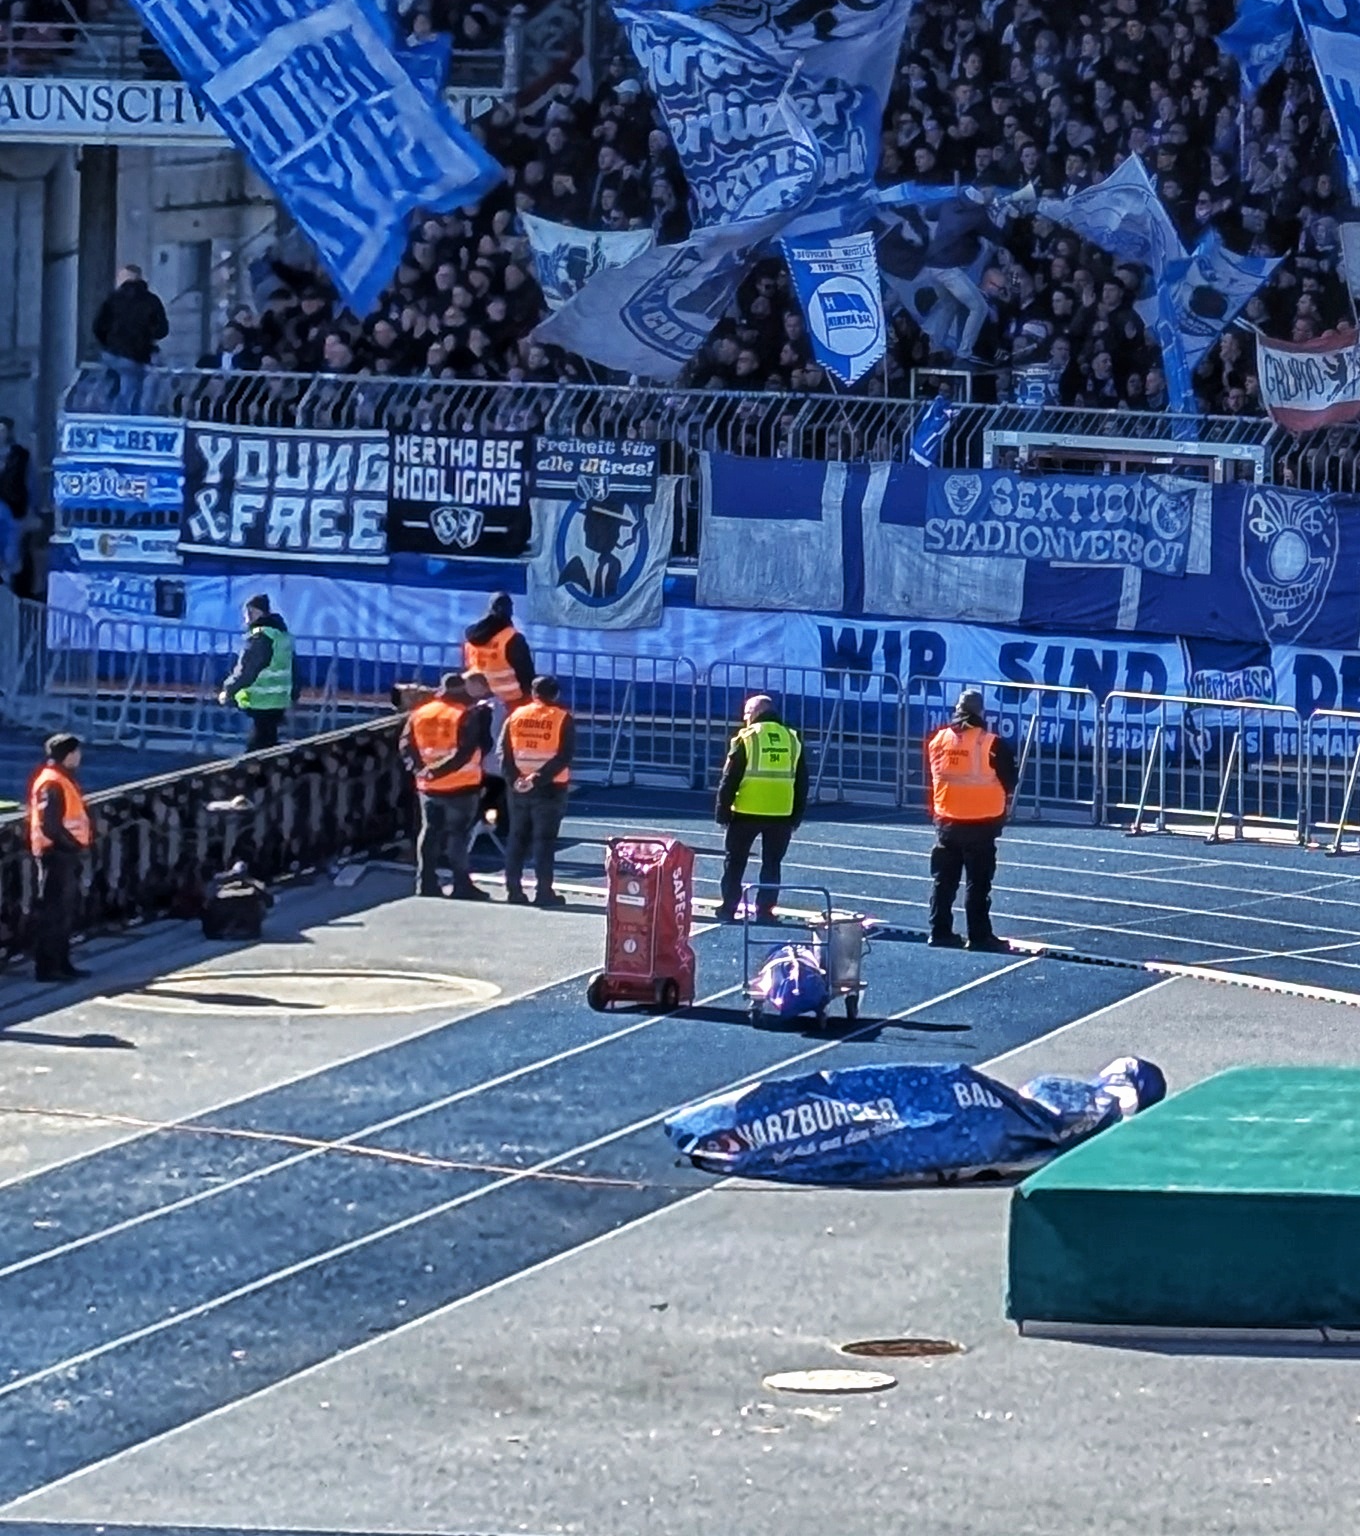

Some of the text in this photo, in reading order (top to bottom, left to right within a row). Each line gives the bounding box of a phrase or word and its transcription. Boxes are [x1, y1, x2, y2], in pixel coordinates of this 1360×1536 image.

[198, 434, 388, 492] YOUNG
[395, 435, 523, 470] HERTHA BSC
[393, 467, 521, 506] HOOLIGANS
[990, 476, 1158, 524] SEKTION
[924, 518, 1184, 572] STADIONVERBOT
[817, 625, 948, 698] WIR
[994, 635, 1168, 716] SIND
